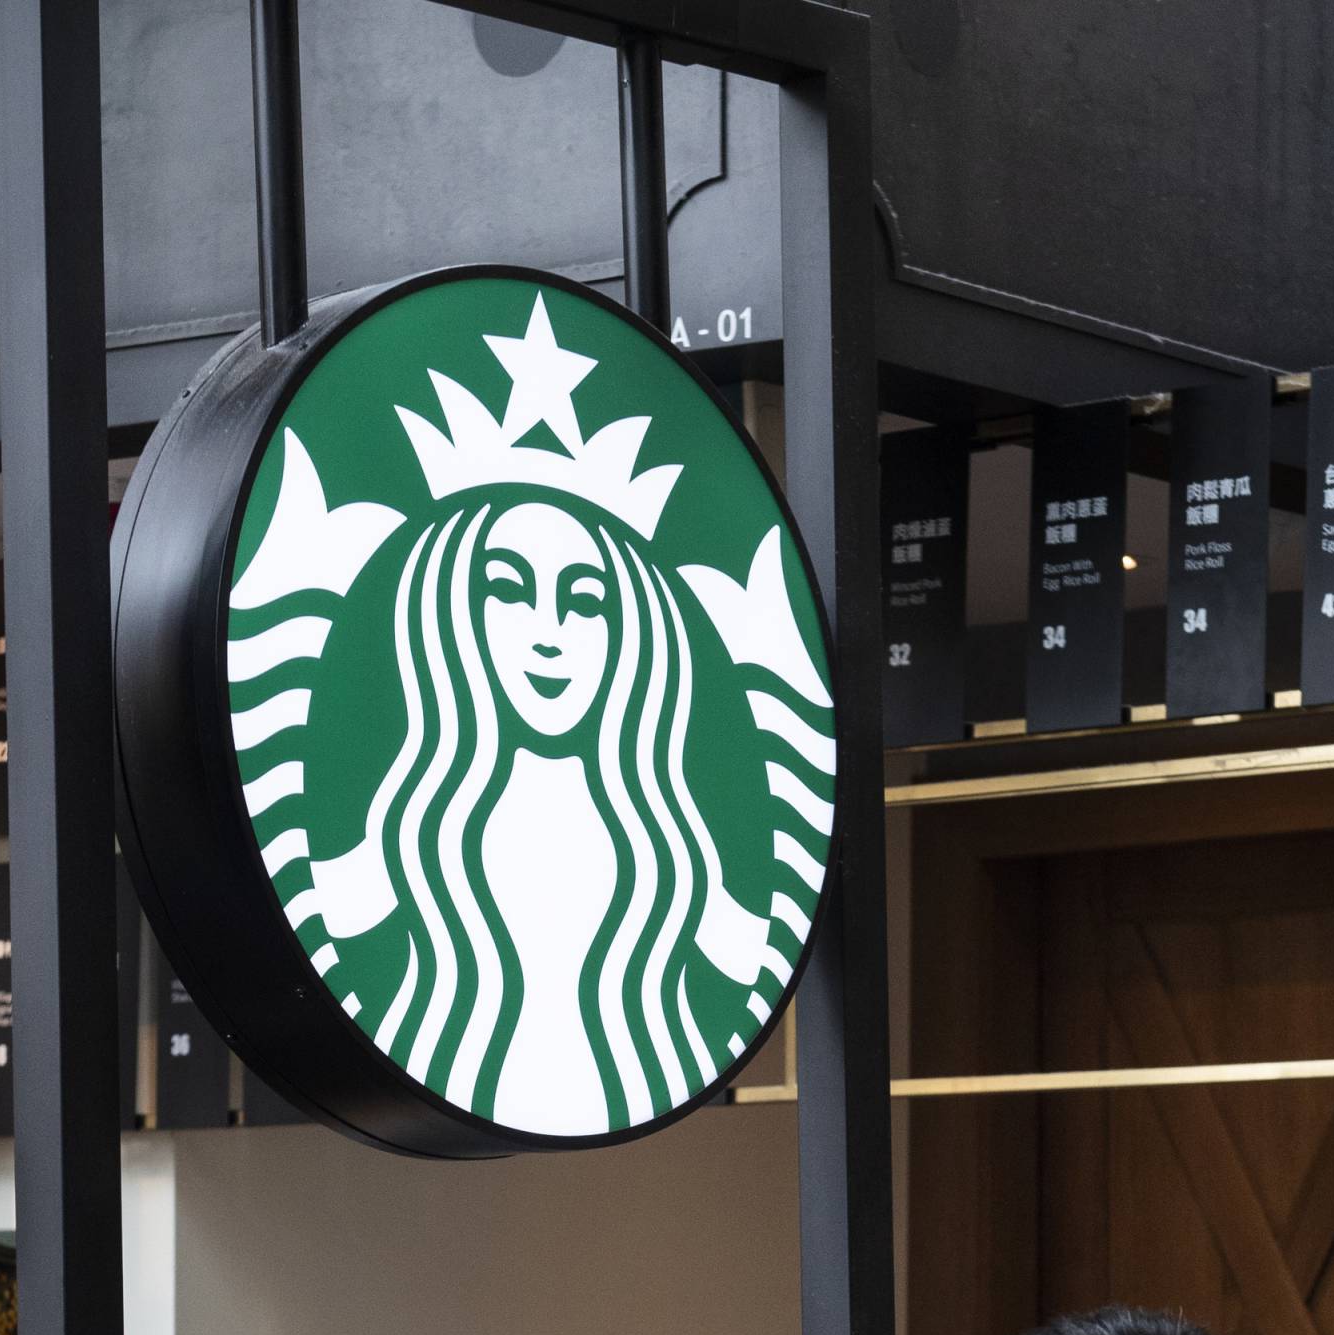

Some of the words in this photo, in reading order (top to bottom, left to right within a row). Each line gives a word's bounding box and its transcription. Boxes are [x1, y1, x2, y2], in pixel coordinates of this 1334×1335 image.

[671, 316, 691, 348] A
[717, 306, 752, 343] 01
[1185, 543, 1206, 556] Pork
[1207, 541, 1233, 554] Floss
[1184, 559, 1205, 571] Rice
[1205, 555, 1225, 569] Roll
[1183, 608, 1208, 633] 34
[1042, 625, 1066, 649] 34
[889, 643, 911, 667] 32
